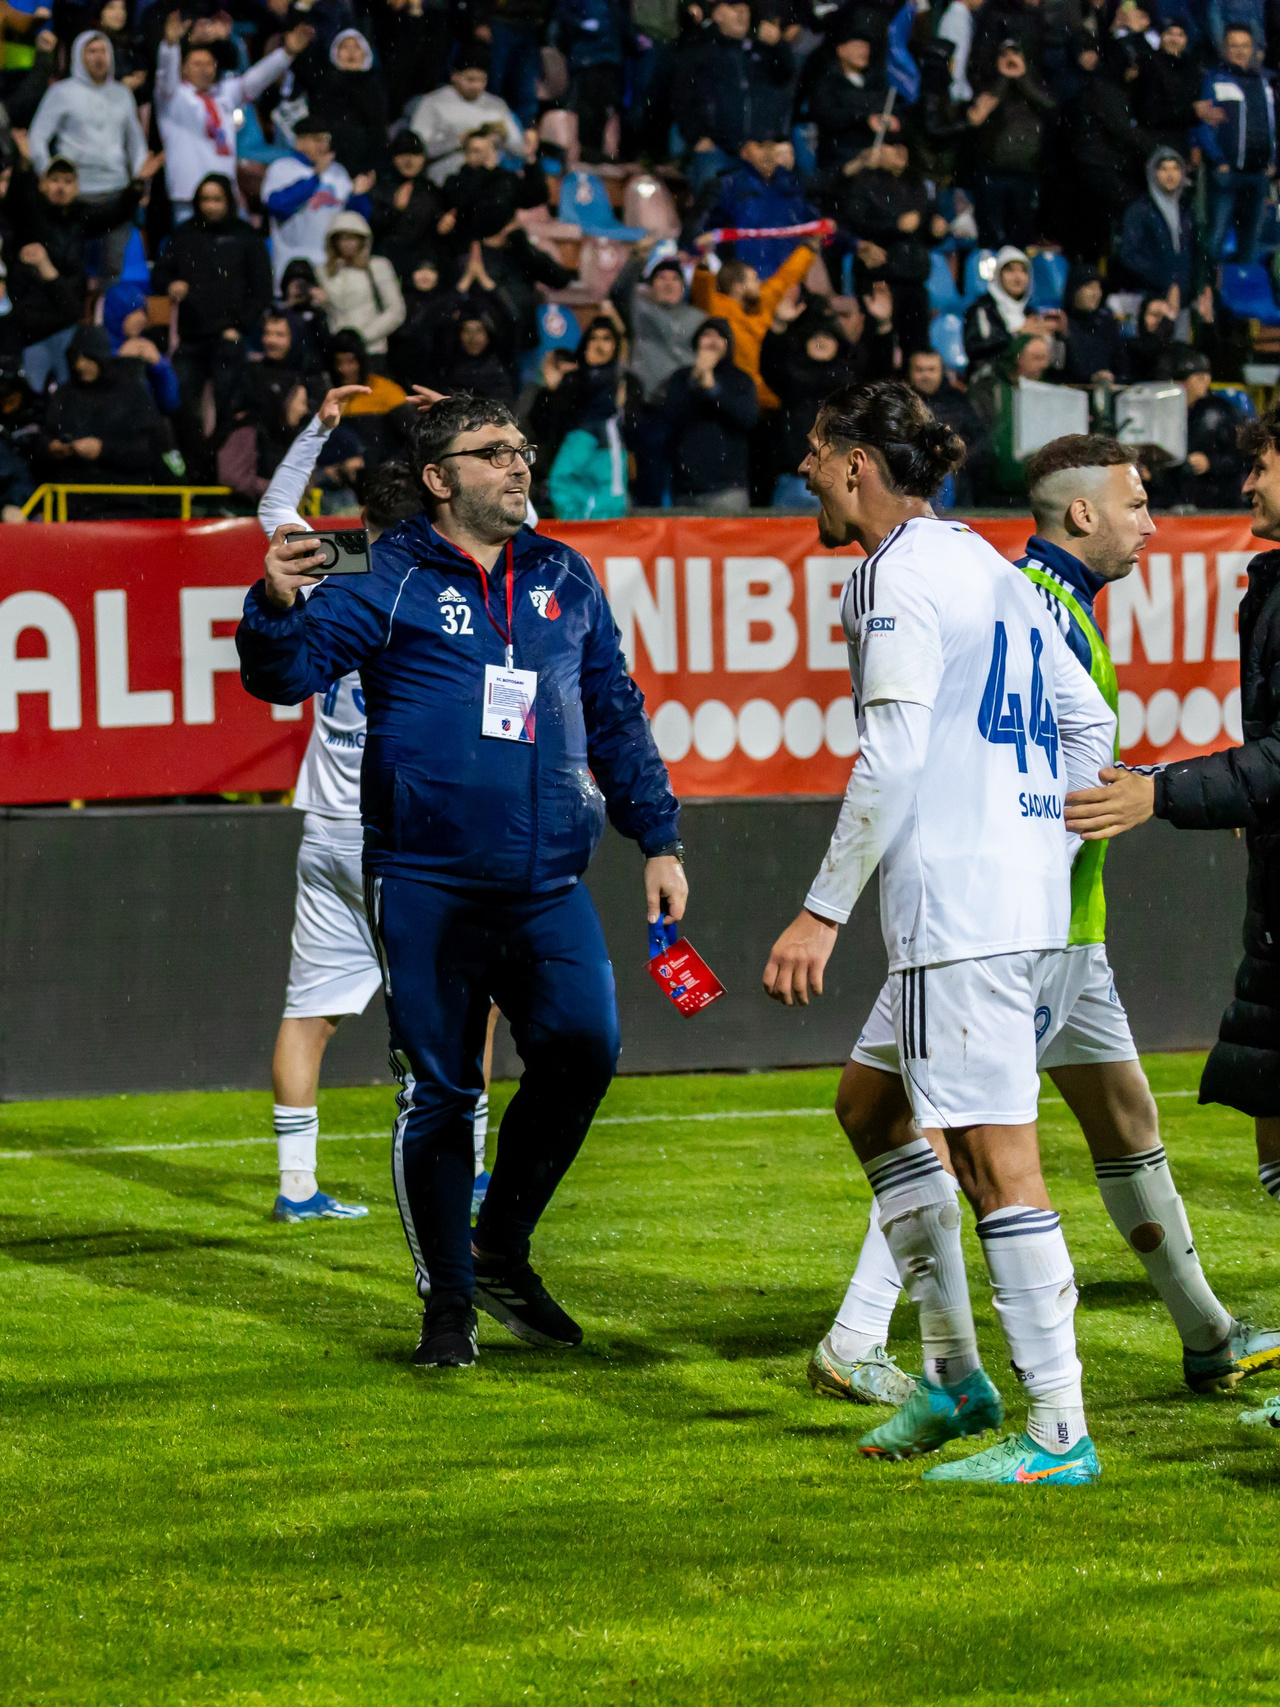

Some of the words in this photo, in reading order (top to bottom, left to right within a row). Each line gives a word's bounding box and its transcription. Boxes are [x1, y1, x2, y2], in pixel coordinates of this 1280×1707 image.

[440, 604, 474, 634] 32
[586, 555, 861, 674] NIBE
[868, 619, 894, 629] ON
[977, 621, 1058, 779] 44
[1019, 792, 1061, 819] SADIKU
